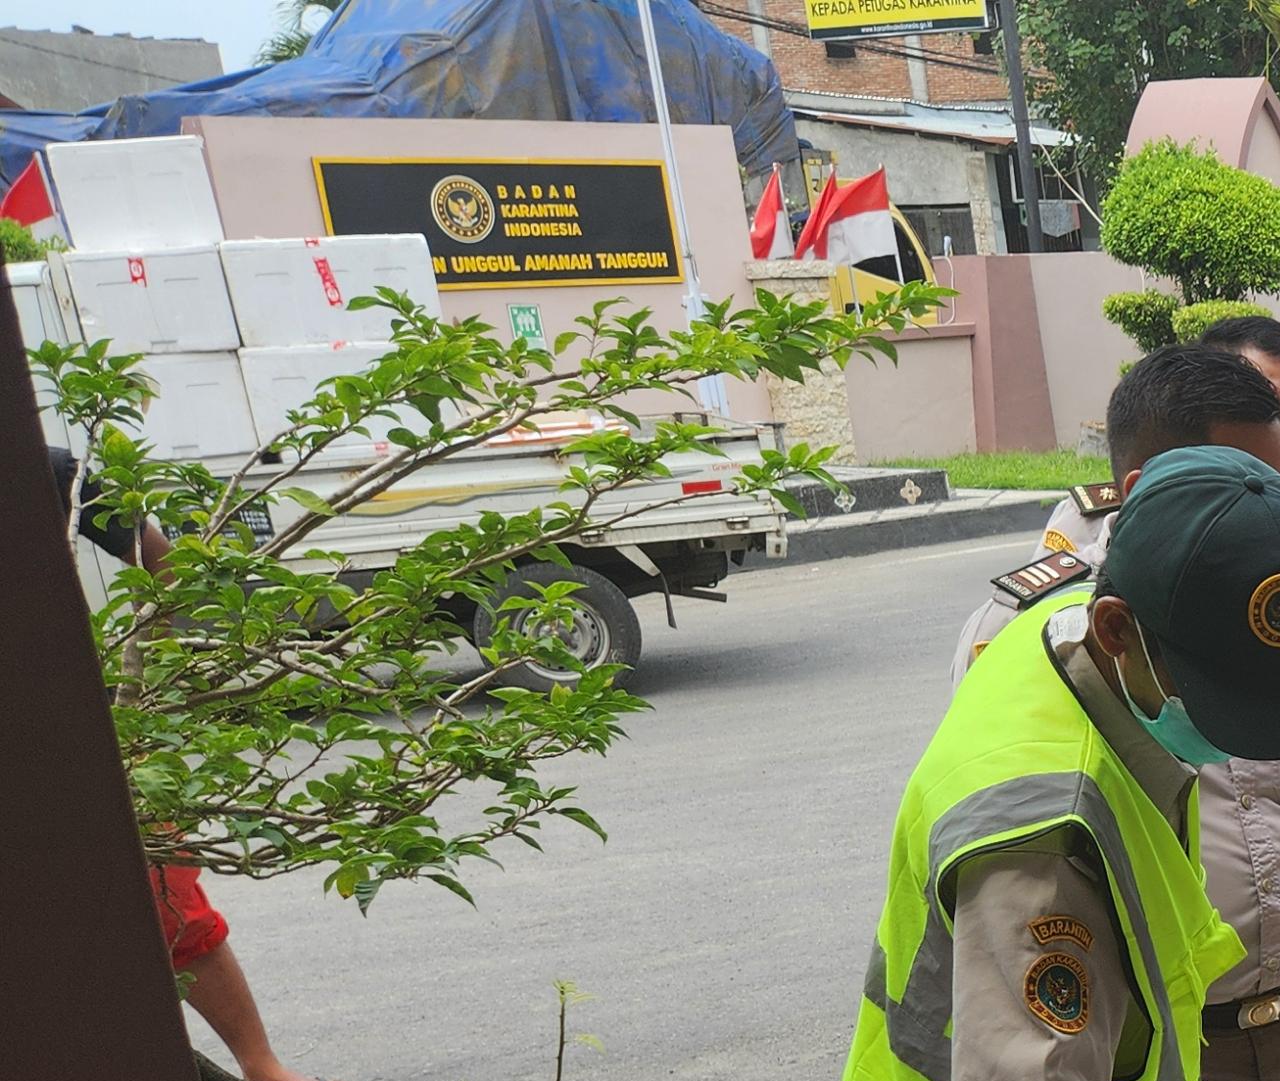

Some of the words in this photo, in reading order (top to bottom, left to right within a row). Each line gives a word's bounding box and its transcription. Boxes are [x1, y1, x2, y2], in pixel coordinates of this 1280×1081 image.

[811, 1, 856, 17] KEPADA
[858, 0, 906, 14] PETUGAS
[497, 185, 576, 200] BADAN
[501, 203, 579, 218] KARANTINA
[505, 222, 582, 237] INDONESIA
[451, 255, 521, 274] UNGGUL
[525, 253, 593, 272] AMANAH
[596, 251, 669, 270] TANGGUH
[1040, 921, 1091, 947] BARANTIN
